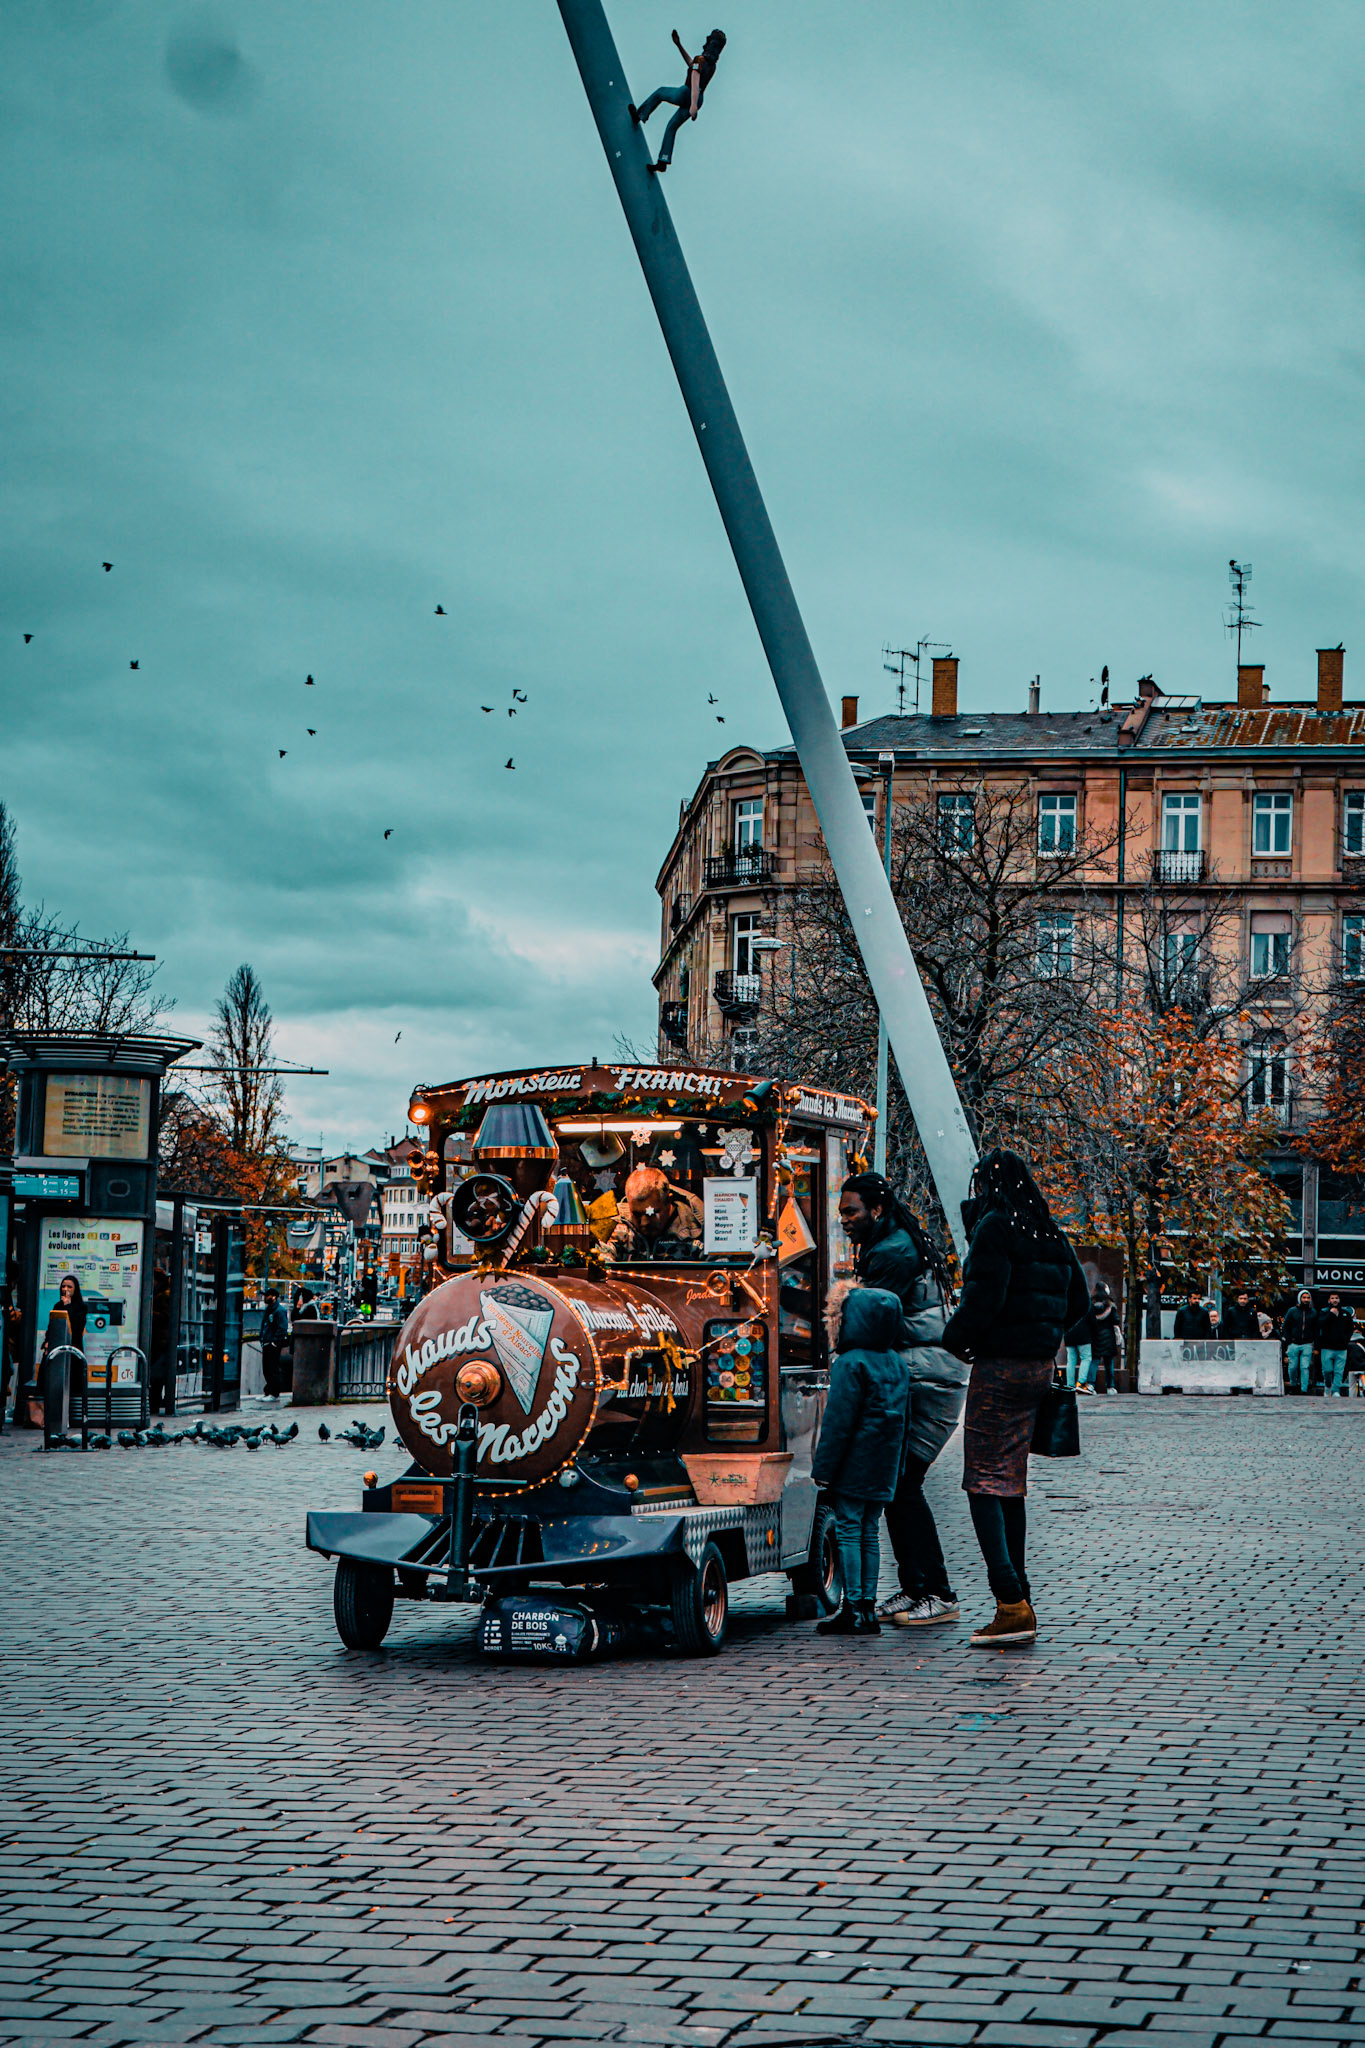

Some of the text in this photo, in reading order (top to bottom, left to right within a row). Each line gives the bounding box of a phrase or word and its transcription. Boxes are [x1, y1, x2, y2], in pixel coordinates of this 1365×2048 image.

[464, 1073, 582, 1106] Monsieur
[823, 1095, 835, 1118] les
[835, 1097, 864, 1123] Marrons
[48, 1229, 61, 1239] Les
[62, 1229, 85, 1241] lignes
[48, 1241, 81, 1251] évoluent
[1317, 1269, 1364, 1281] MONC
[486, 1303, 515, 1331] Dernières
[568, 1297, 635, 1331] Marrons
[673, 1373, 689, 1396] bois
[450, 1337, 581, 1464] Marrons
[511, 1621, 548, 1631] DE BOIS
[512, 1612, 559, 1622] CHARBON
